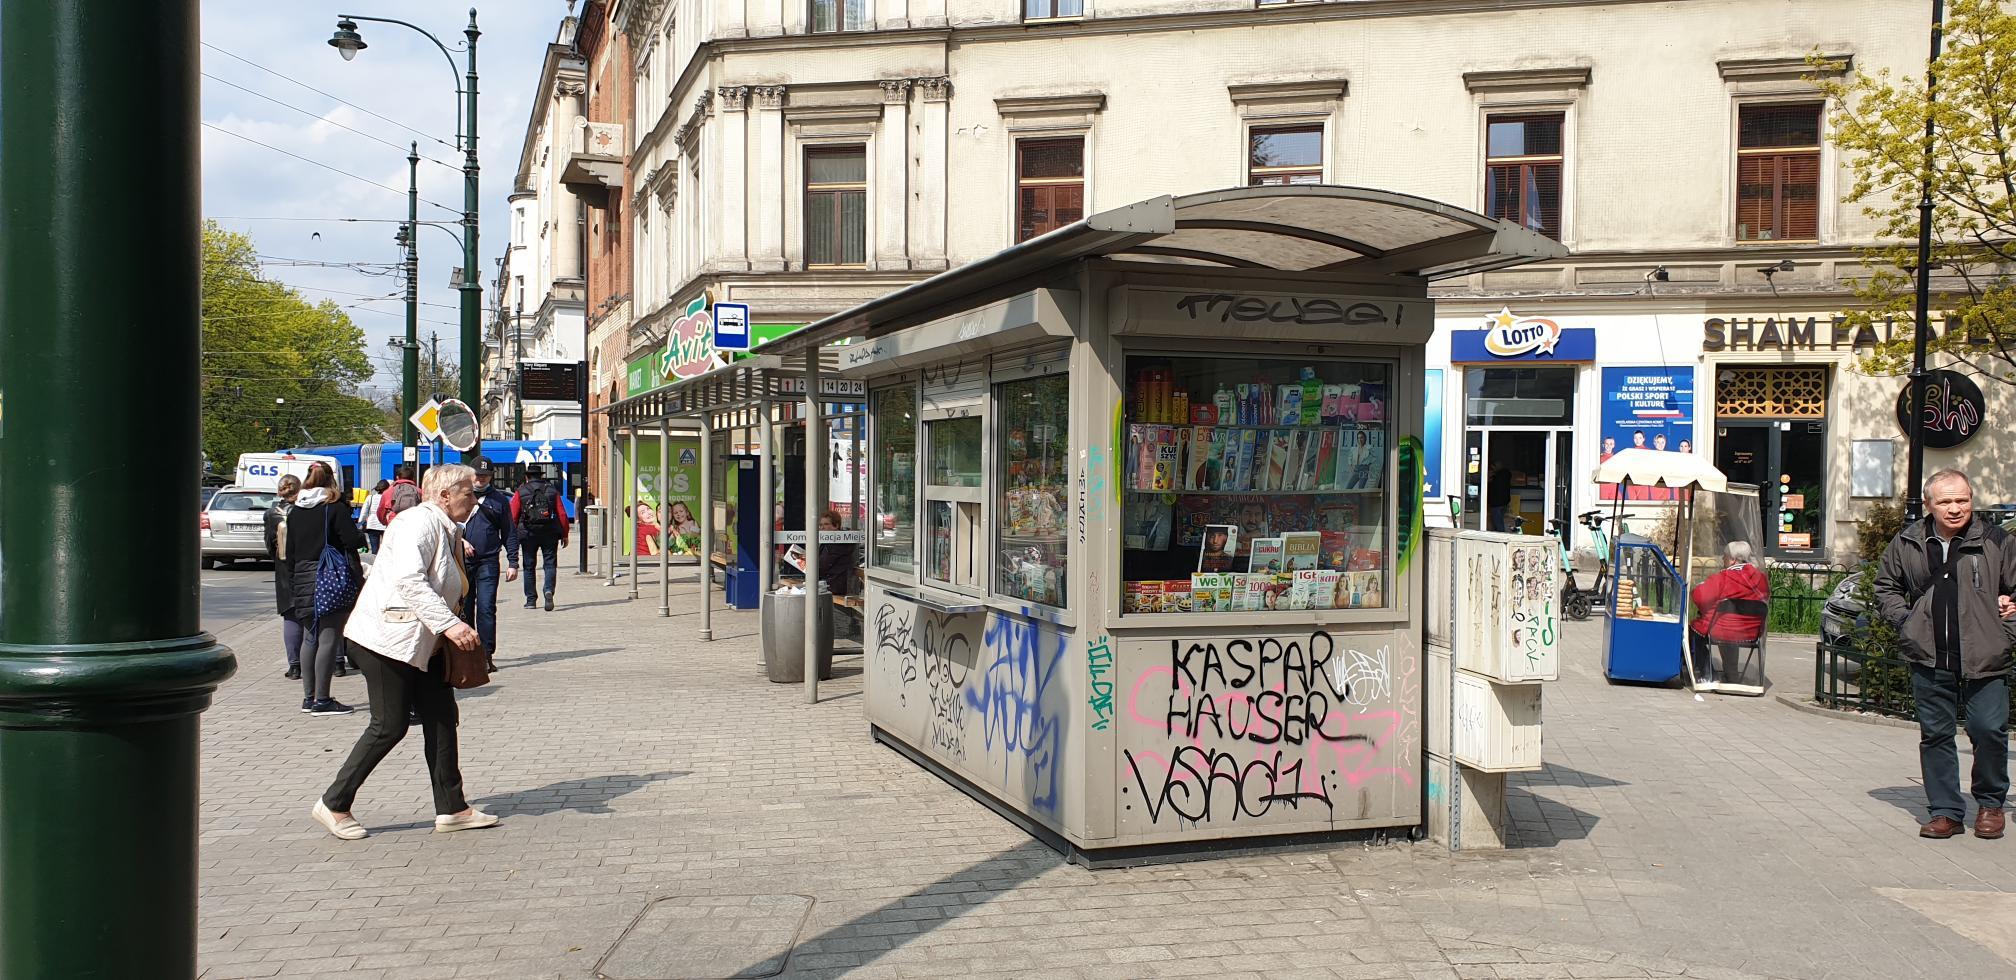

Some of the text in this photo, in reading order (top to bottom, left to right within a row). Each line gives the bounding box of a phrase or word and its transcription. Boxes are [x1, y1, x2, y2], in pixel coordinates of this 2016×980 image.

[1501, 324, 1544, 346] LOTTO
[1703, 317, 1816, 351] SHAM
[661, 319, 714, 377] Avit
[799, 380, 805, 390] 2
[826, 382, 834, 391] 14
[840, 382, 848, 392] 20
[854, 382, 862, 392] 24
[1616, 392, 1669, 400] POLSKI SPORT
[1634, 400, 1665, 408] KULTURĘ
[249, 465, 278, 476] GLS
[786, 533, 866, 543] Komkacja Miejs
[1289, 543, 1316, 551] BIBLIA
[1172, 631, 1348, 703] KASPAR
[1167, 691, 1374, 745] HAUSER
